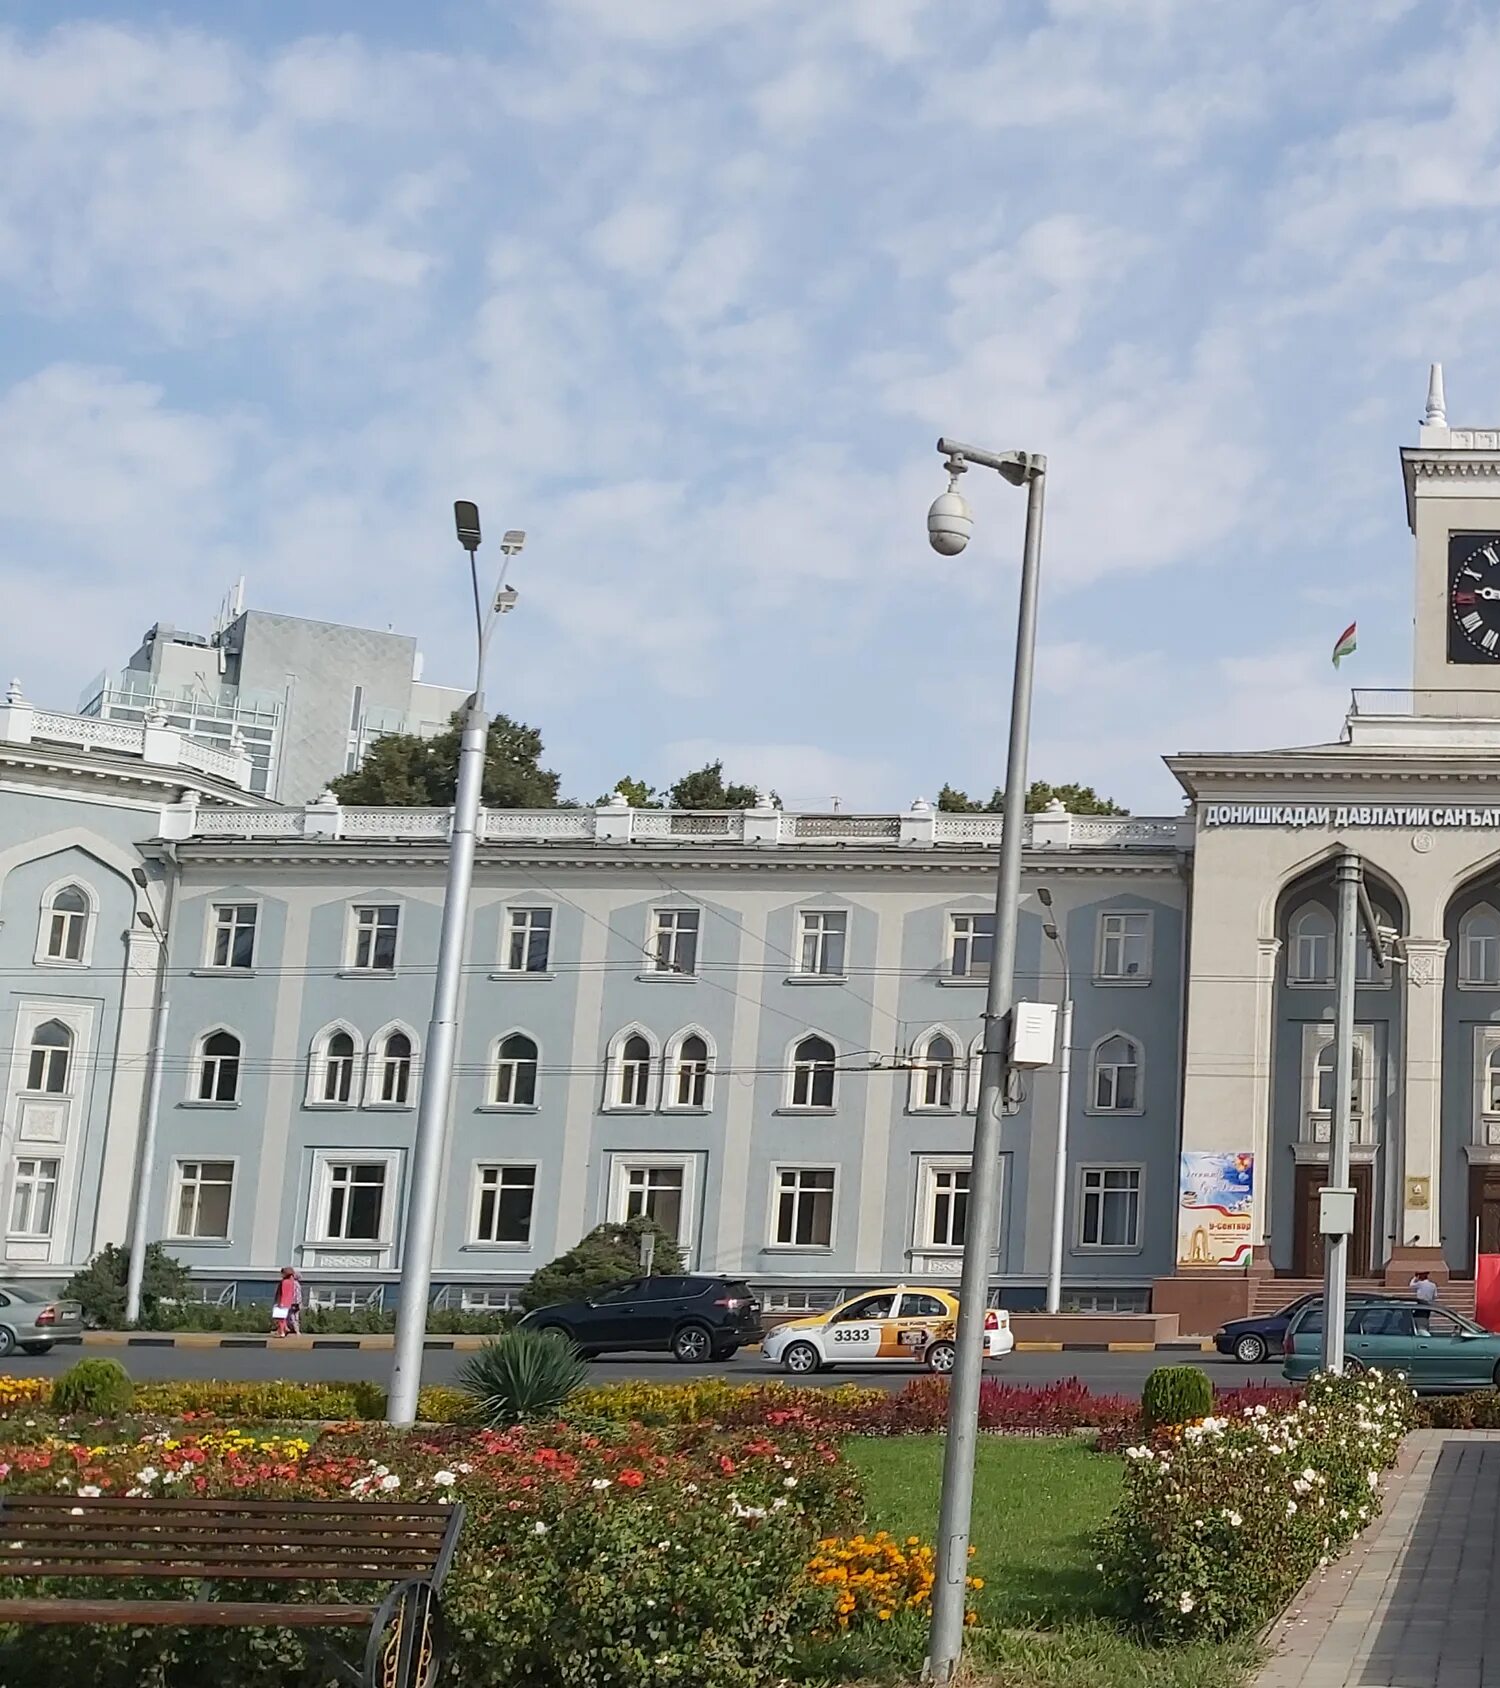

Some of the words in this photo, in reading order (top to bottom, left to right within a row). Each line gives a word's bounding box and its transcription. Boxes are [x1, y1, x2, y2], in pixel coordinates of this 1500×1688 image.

[1482, 547, 1500, 566] XI
[1205, 805, 1330, 828] ДОНИШКАДАИ
[1334, 806, 1429, 828] ДАВЛАТИИ
[834, 1329, 870, 1341] 3333
